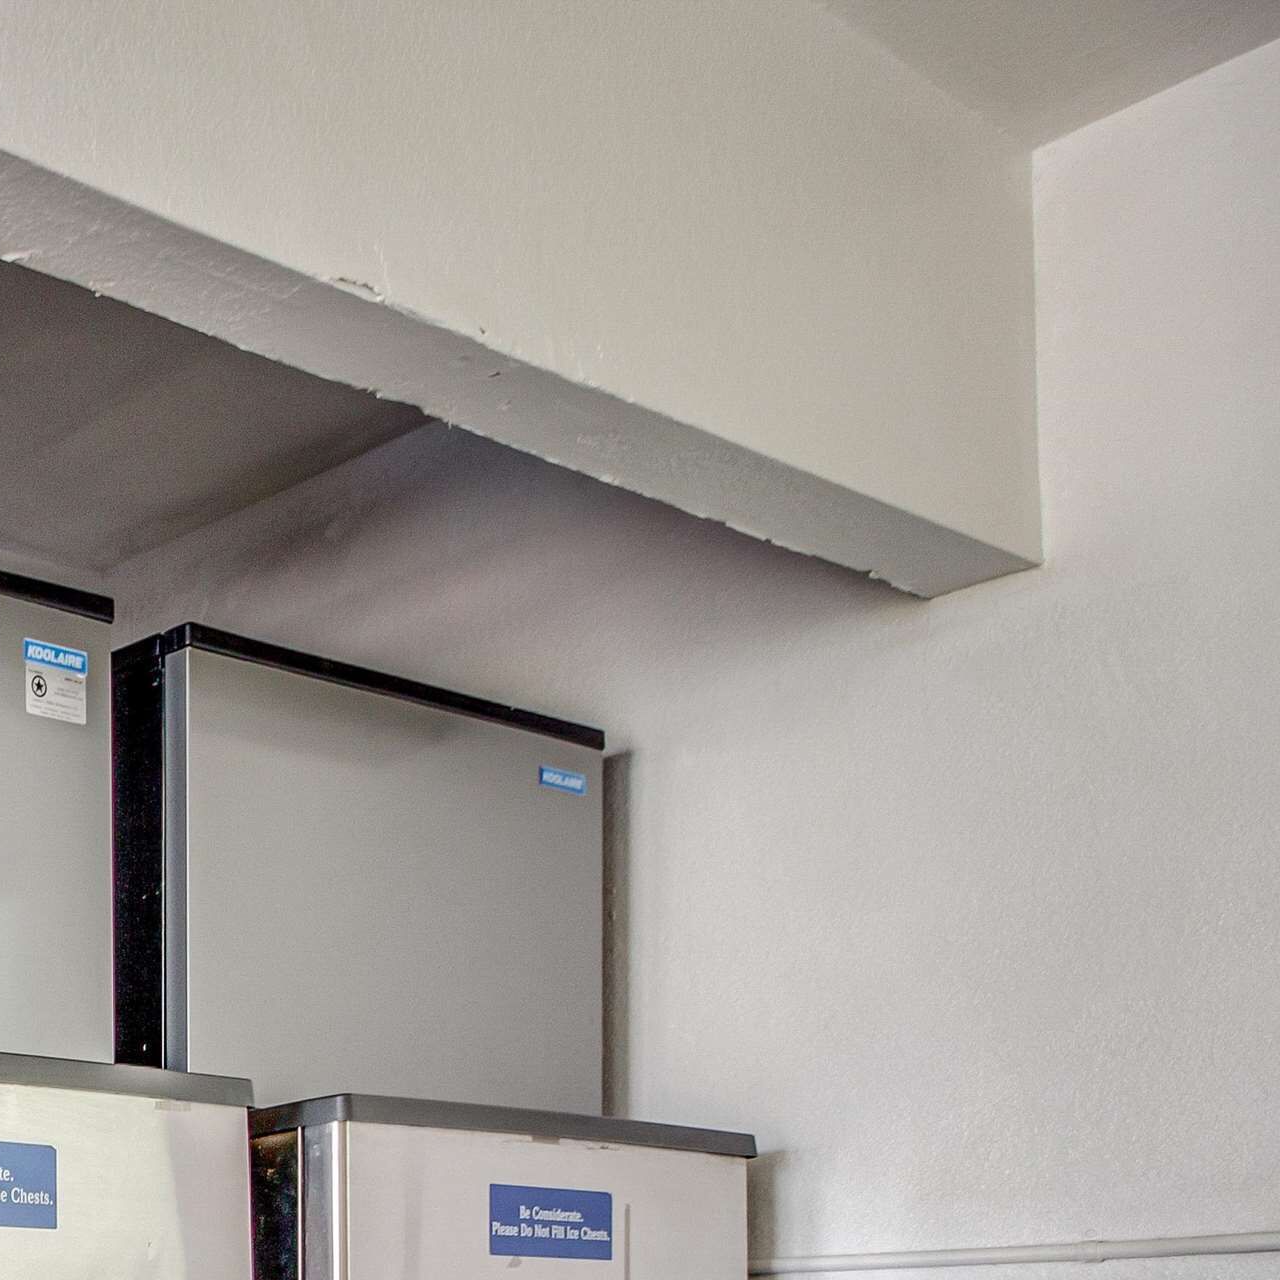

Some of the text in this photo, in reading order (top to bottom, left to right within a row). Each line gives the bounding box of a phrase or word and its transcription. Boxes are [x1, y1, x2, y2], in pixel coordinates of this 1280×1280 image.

[27, 644, 84, 669] KOOLAIRE
[11, 1187, 54, 1206] Chests.
[519, 1205, 530, 1219] Be
[491, 1221, 519, 1236] Please
[520, 1223, 532, 1237] Do
[534, 1224, 550, 1238] Not
[551, 1225, 565, 1239] Fill
[566, 1226, 579, 1240] Ice
